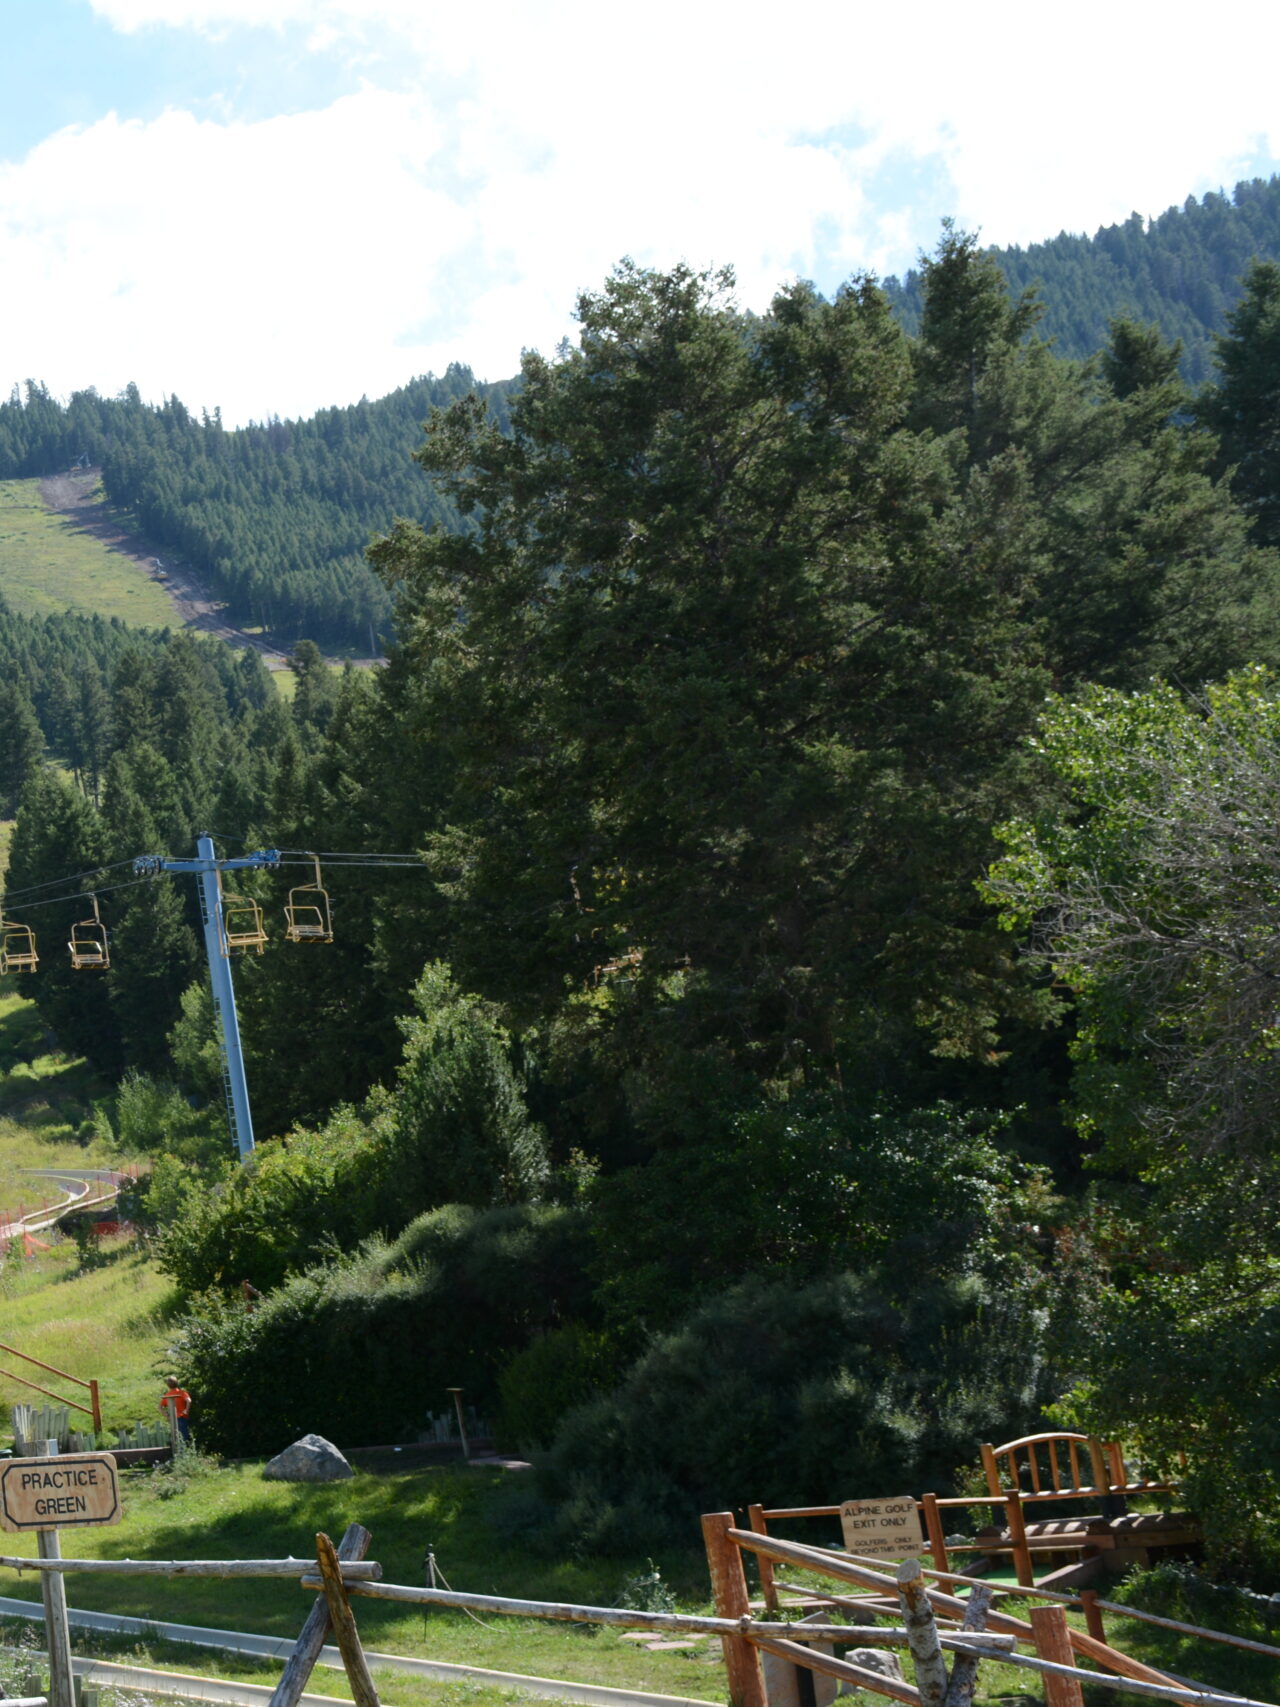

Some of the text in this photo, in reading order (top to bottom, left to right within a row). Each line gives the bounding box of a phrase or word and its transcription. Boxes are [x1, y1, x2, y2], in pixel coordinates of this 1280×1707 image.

[22, 1469, 98, 1490] PRACTICE
[35, 1496, 86, 1515] GREEN
[844, 1503, 913, 1516] ALPINE GOLF
[853, 1517, 907, 1529] EXIT ONLY
[855, 1538, 887, 1546] GOLFERS
[851, 1547, 879, 1555] BEYOND
[898, 1543, 919, 1551] POINT
